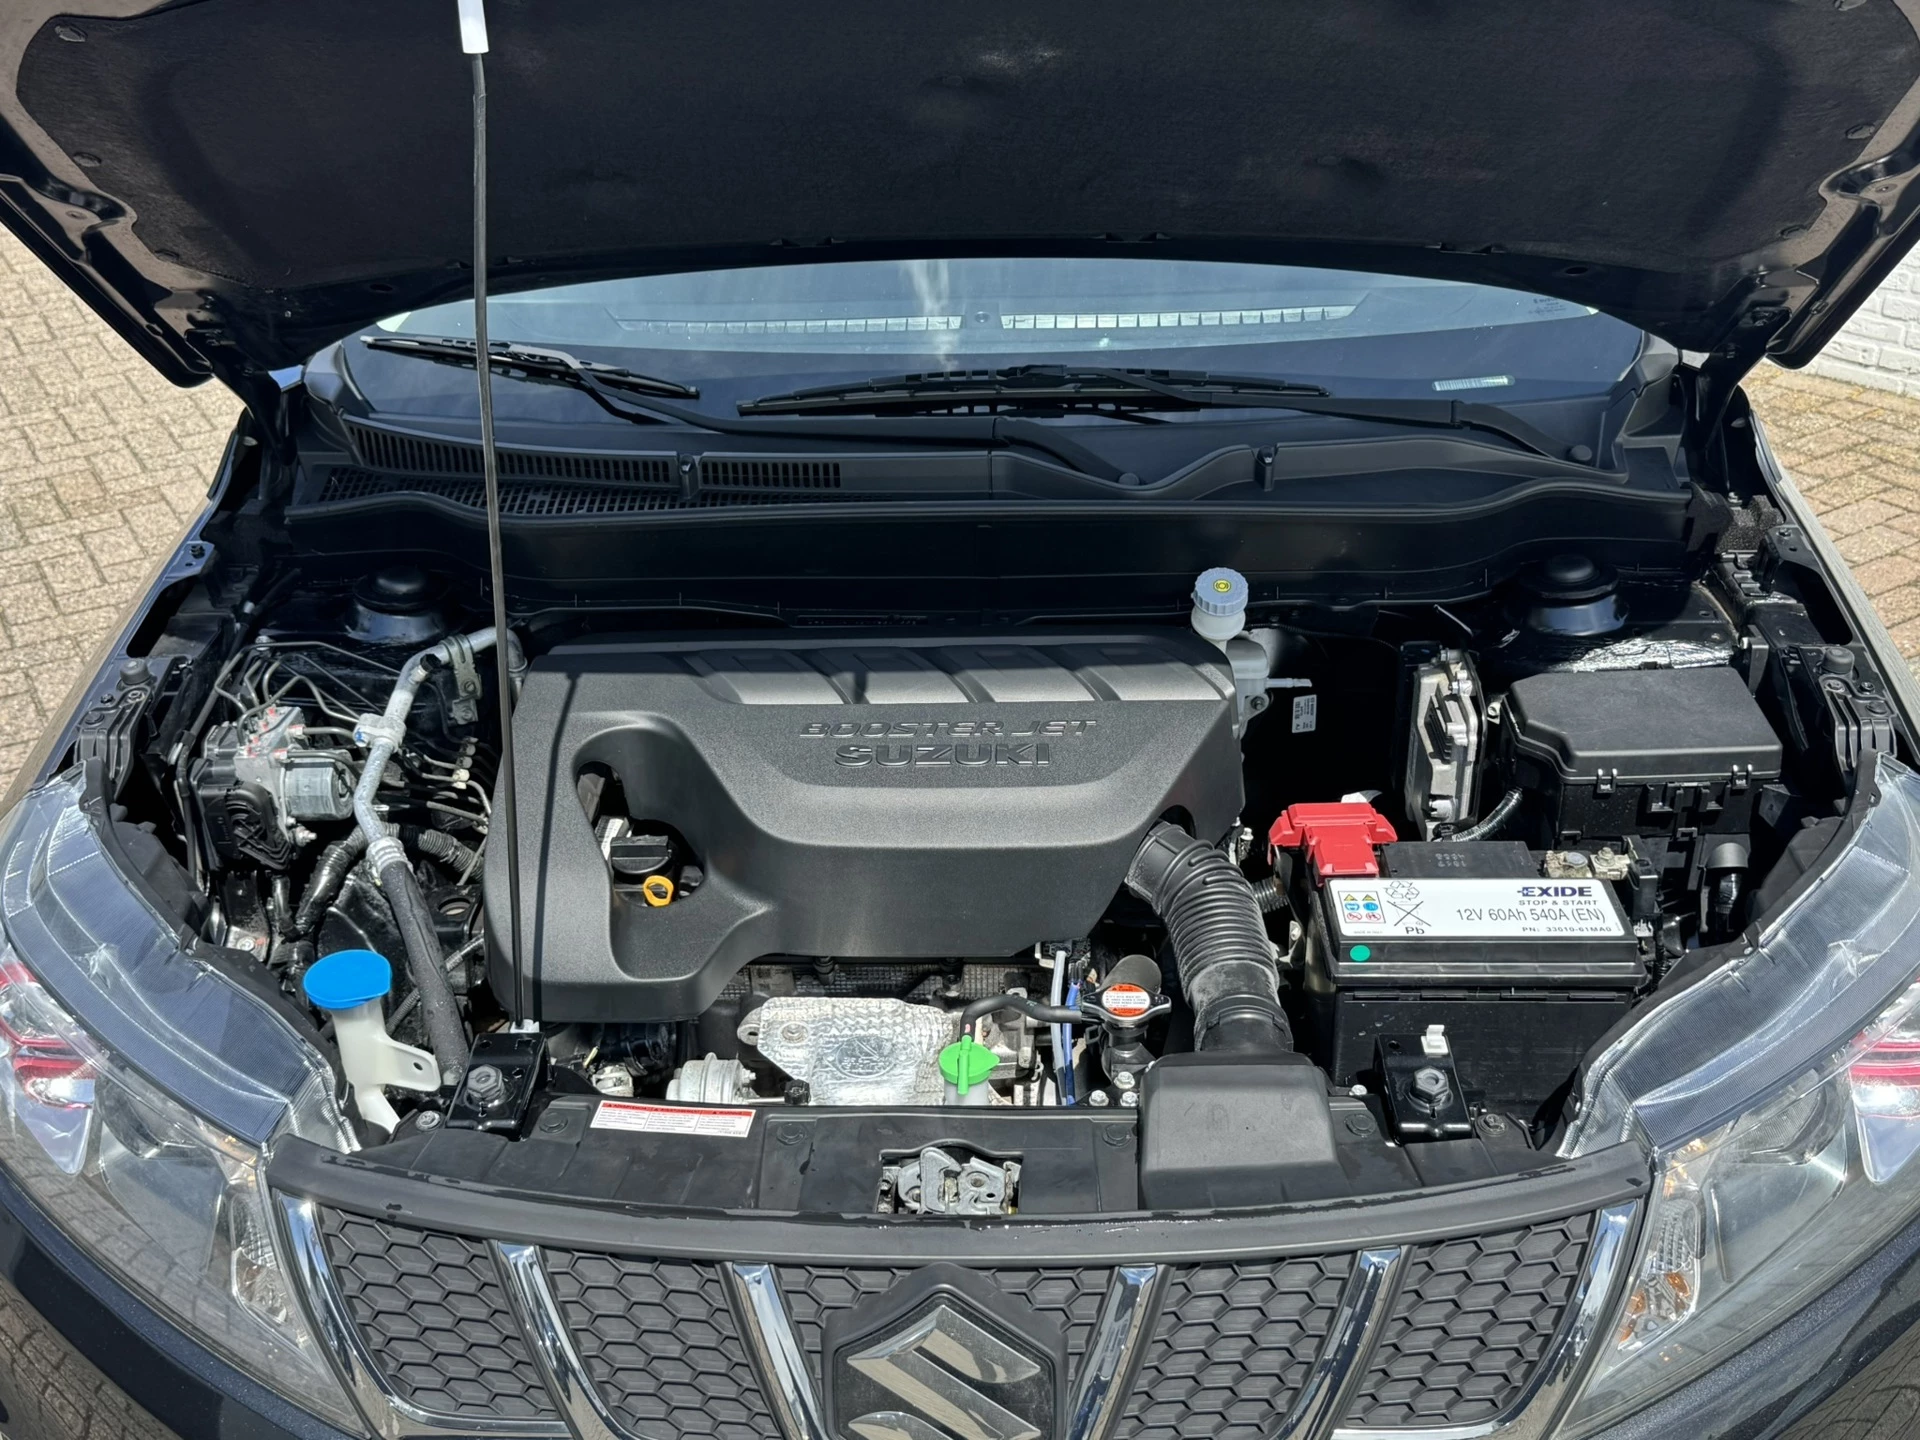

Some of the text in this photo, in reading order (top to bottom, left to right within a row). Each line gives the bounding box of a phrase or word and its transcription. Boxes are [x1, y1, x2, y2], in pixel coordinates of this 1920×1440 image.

[800, 719, 1097, 737] BOOSTER JET
[835, 743, 1050, 766] SUZUKI
[1520, 886, 1593, 897] EXIDE
[1456, 908, 1606, 924] 12V 60Ah 540A (EN)
[1405, 926, 1425, 935] Pb
